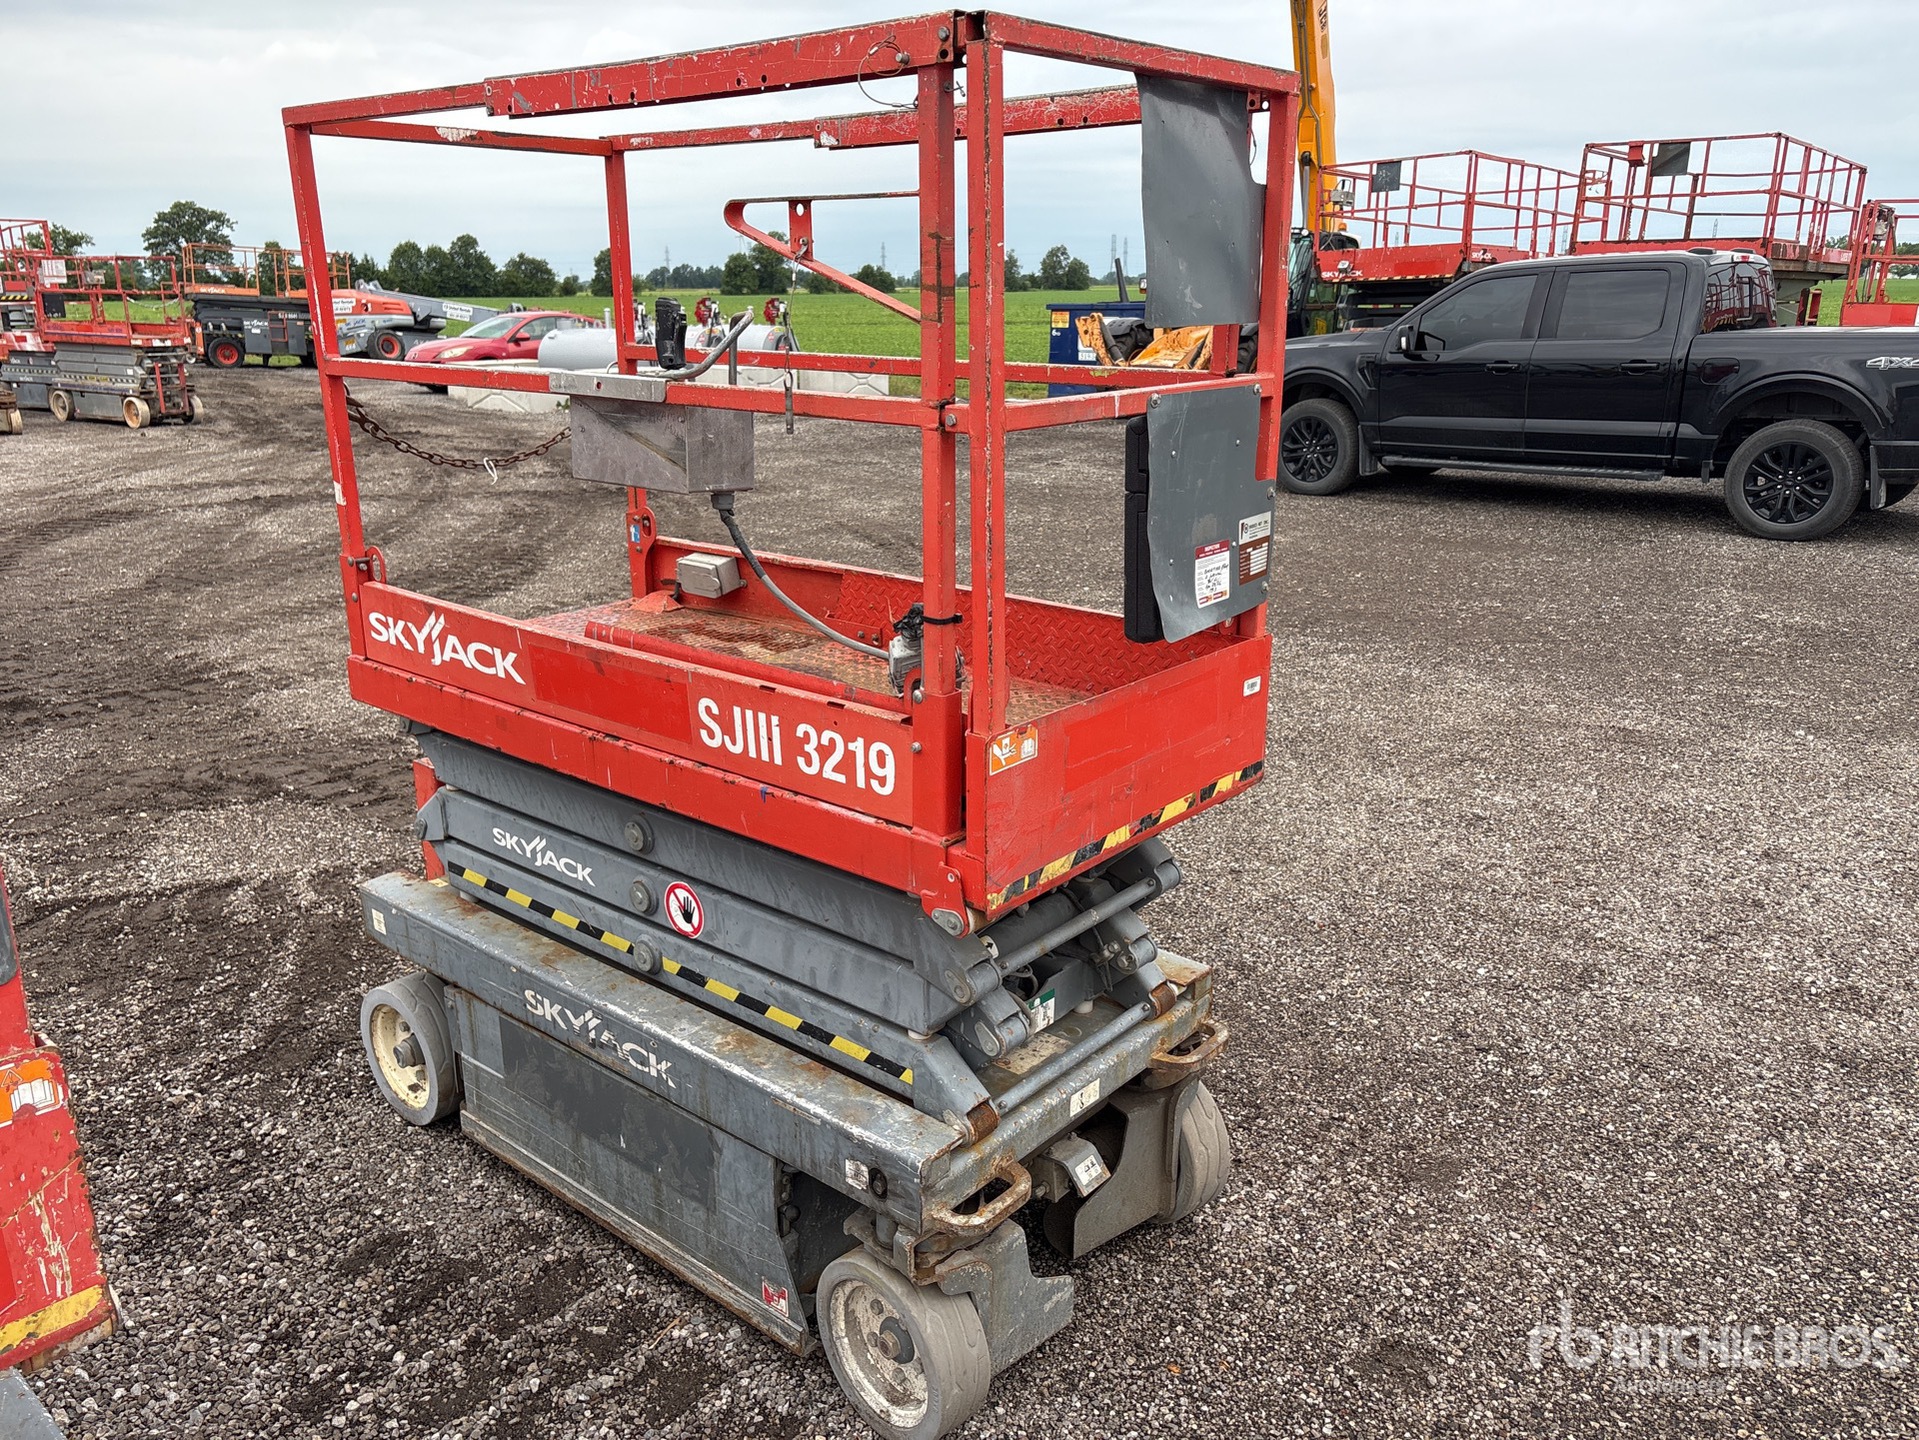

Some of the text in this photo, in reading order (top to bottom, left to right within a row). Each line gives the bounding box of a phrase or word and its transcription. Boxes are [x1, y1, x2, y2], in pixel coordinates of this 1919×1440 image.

[368, 610, 527, 686] SKYJACK
[795, 723, 896, 796] 3219
[492, 827, 596, 888] SKYJACK
